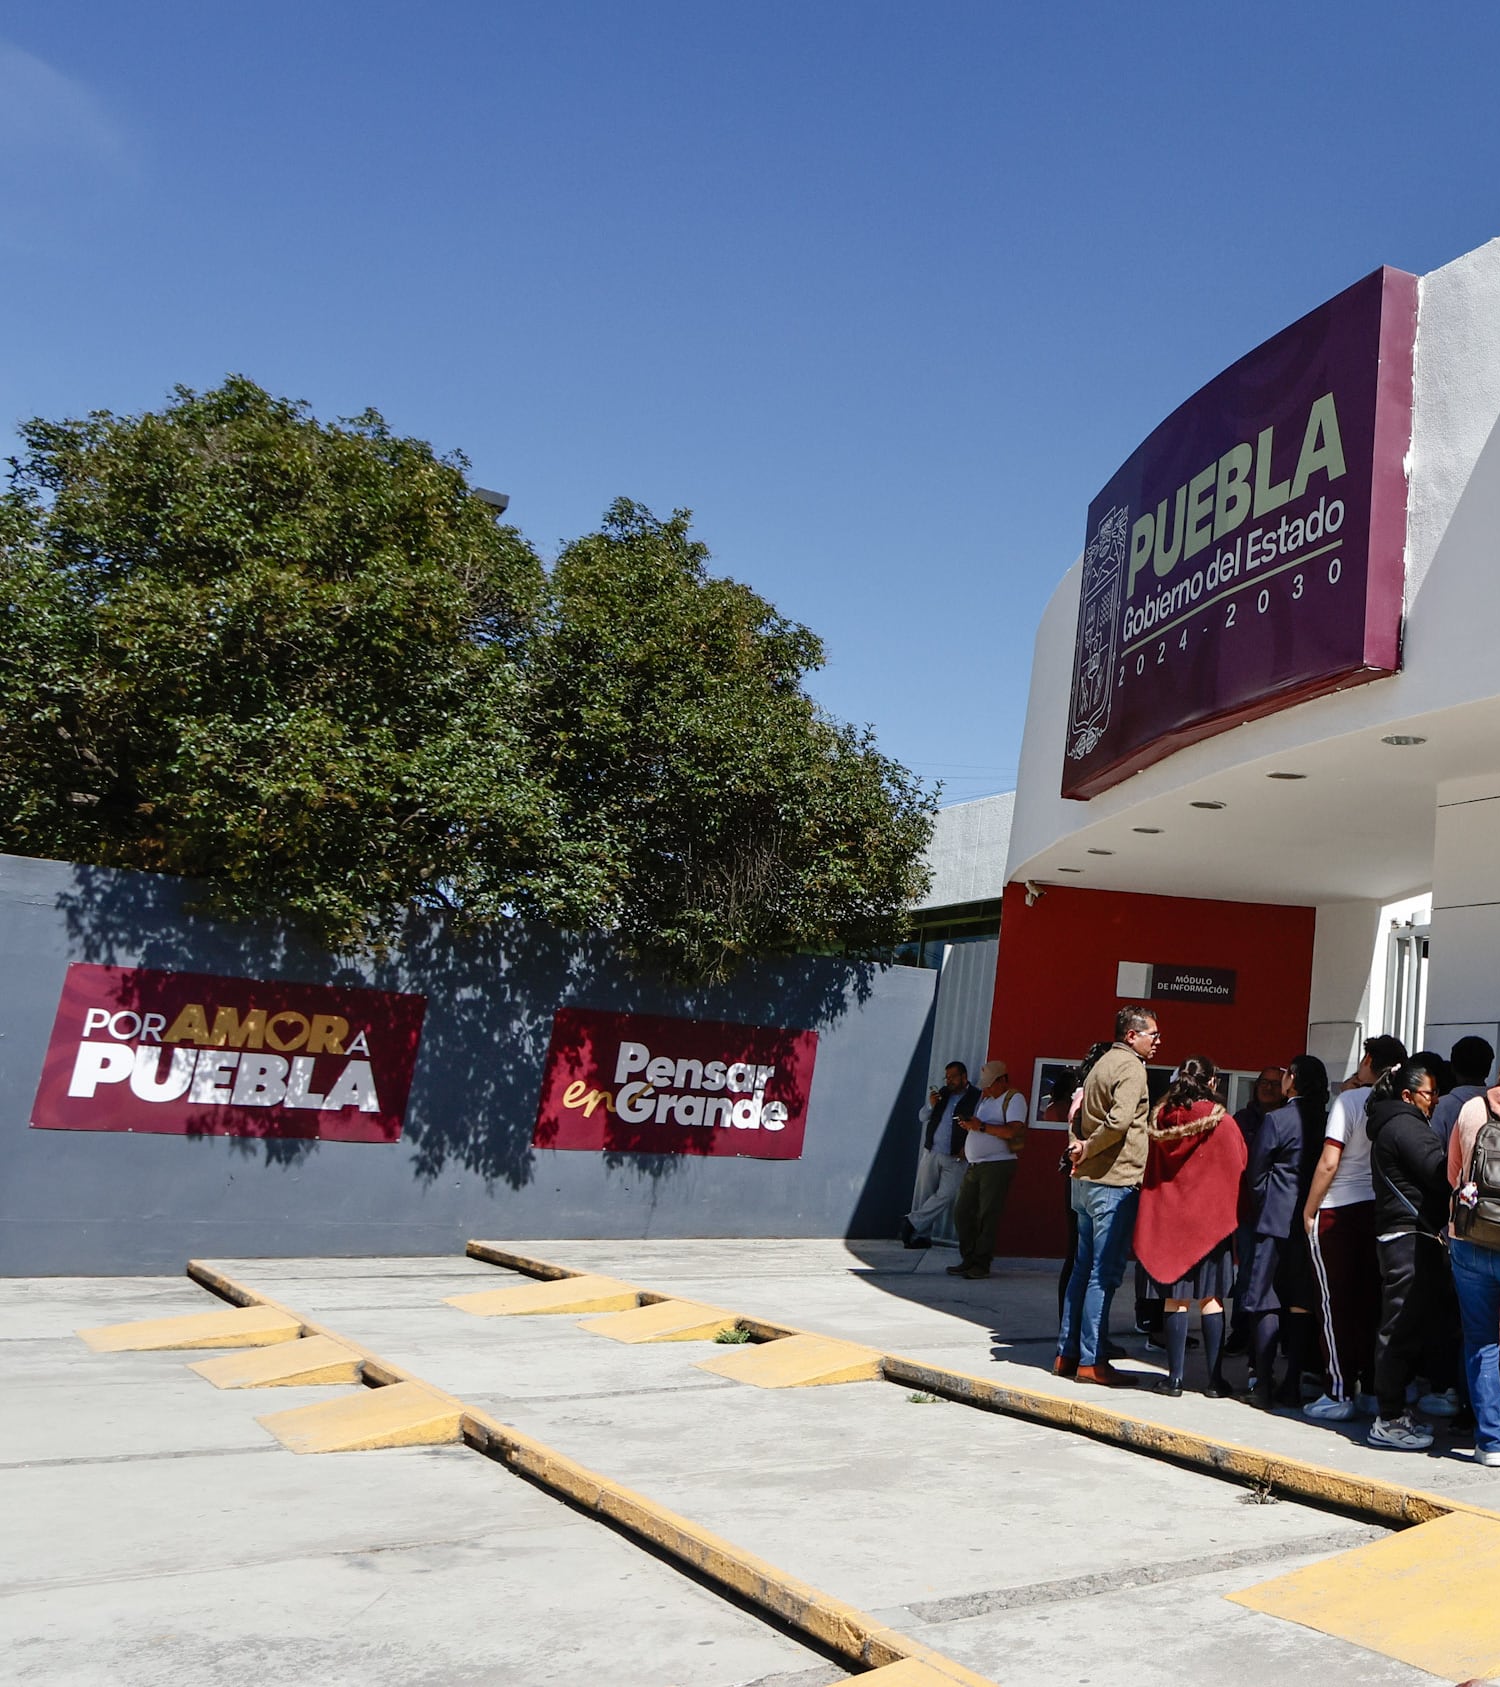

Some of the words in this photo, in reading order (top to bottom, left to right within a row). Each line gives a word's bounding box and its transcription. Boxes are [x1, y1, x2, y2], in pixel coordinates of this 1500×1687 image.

[1126, 391, 1347, 600] PUEBLA
[1122, 570, 1204, 642] Gobierno
[1205, 537, 1242, 591] del
[1245, 495, 1345, 571] Estado
[1118, 558, 1342, 688] 2024-2030
[1157, 982, 1169, 990] DE
[1170, 984, 1229, 995] INFORMACIÓN
[1175, 975, 1212, 985] MÓDULO
[82, 1007, 167, 1042] POR
[162, 1003, 350, 1055] AMOR
[344, 1029, 371, 1057] A
[66, 1040, 381, 1113] PUEBLA
[614, 1041, 776, 1093] Pensar
[562, 1080, 618, 1118] en
[615, 1081, 789, 1132] Grande
